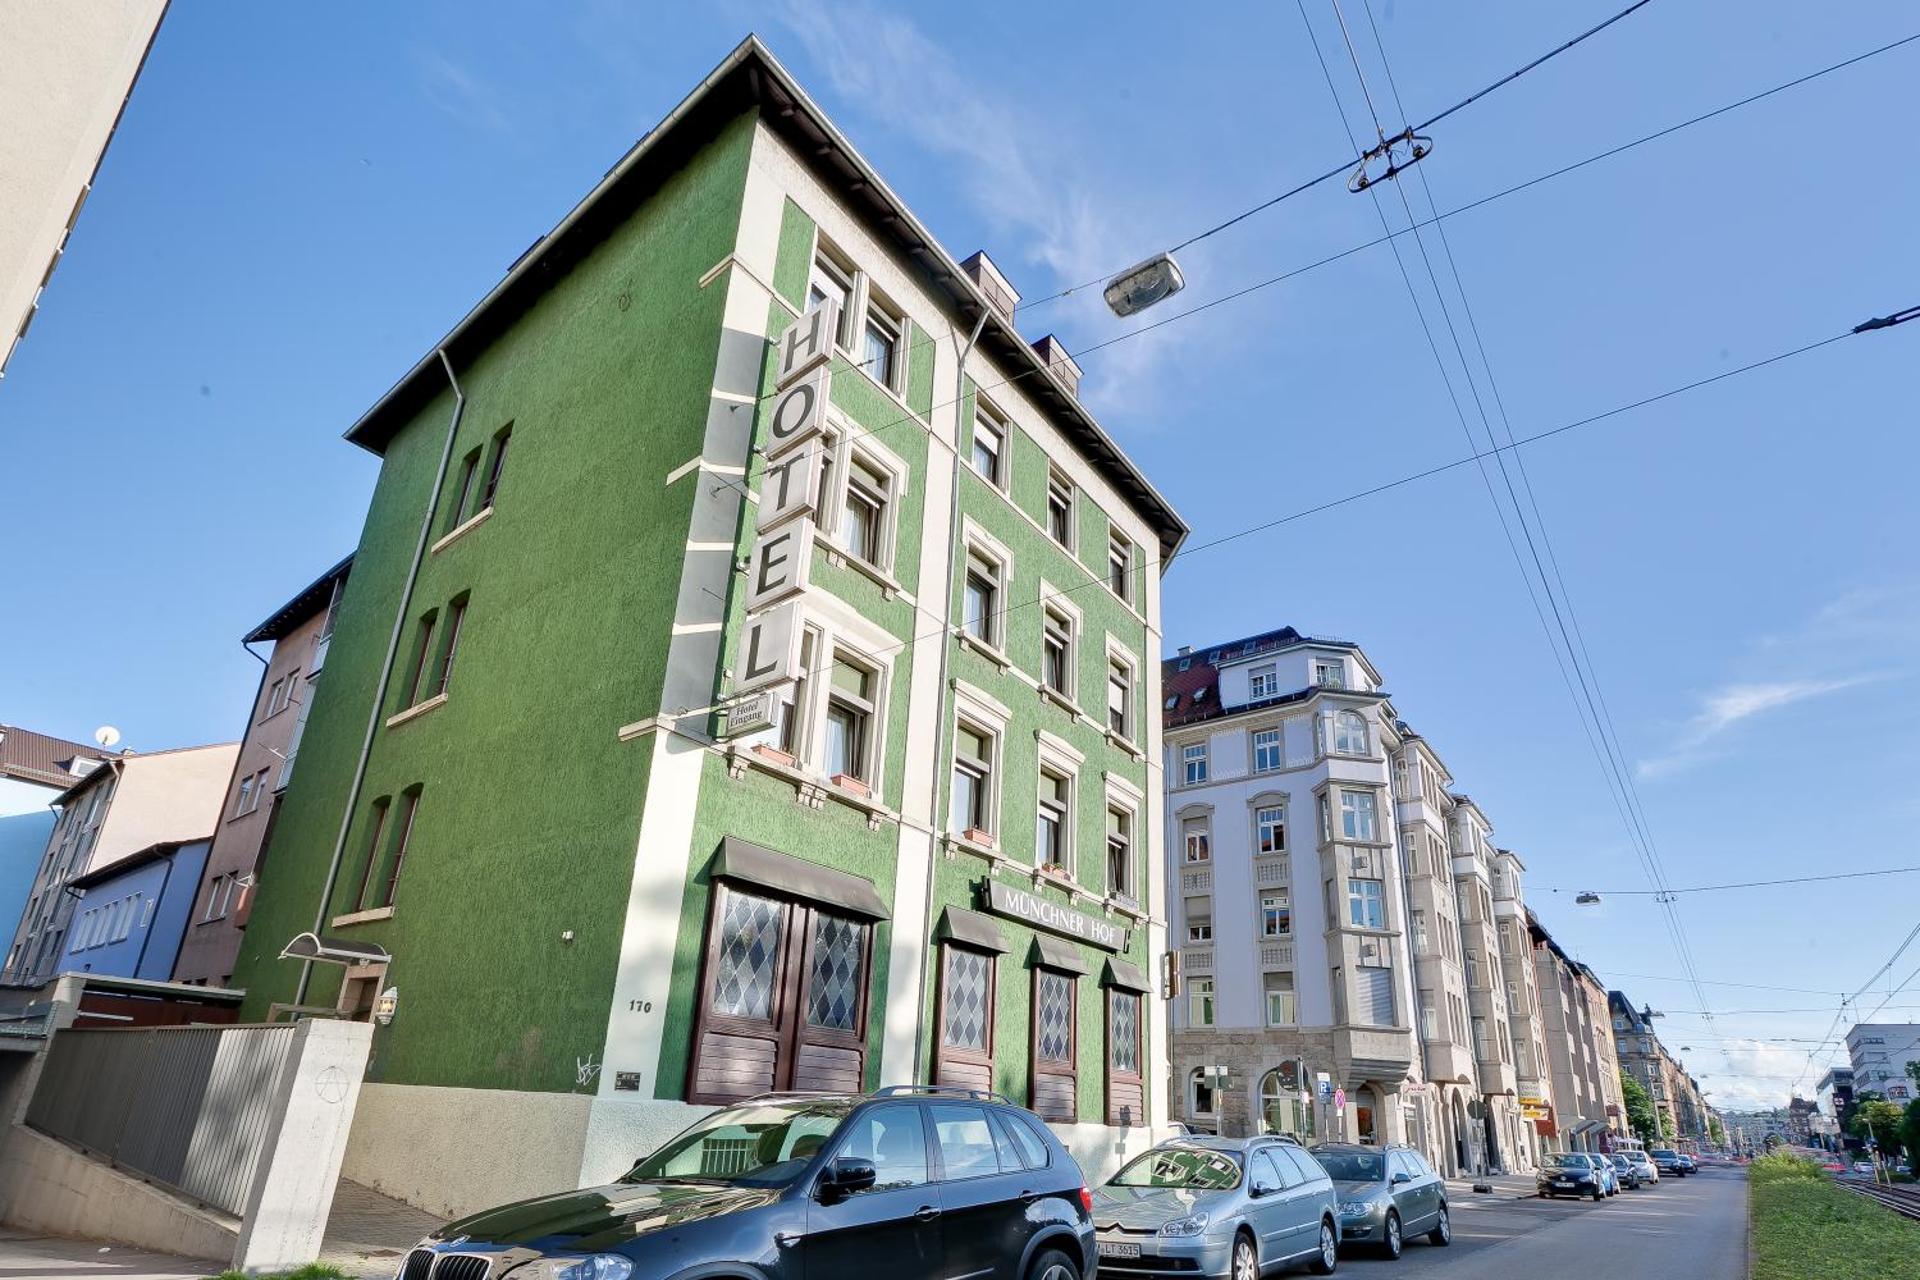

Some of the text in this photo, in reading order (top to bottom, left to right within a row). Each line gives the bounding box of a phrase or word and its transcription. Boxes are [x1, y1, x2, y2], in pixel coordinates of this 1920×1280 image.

[744, 310, 821, 682] HOTEL
[736, 701, 759, 716] Hotel
[730, 711, 763, 727] Eingang
[1005, 890, 1085, 935] MÜNCHNER
[1091, 920, 1115, 944] HOF
[629, 999, 652, 1013] 170
